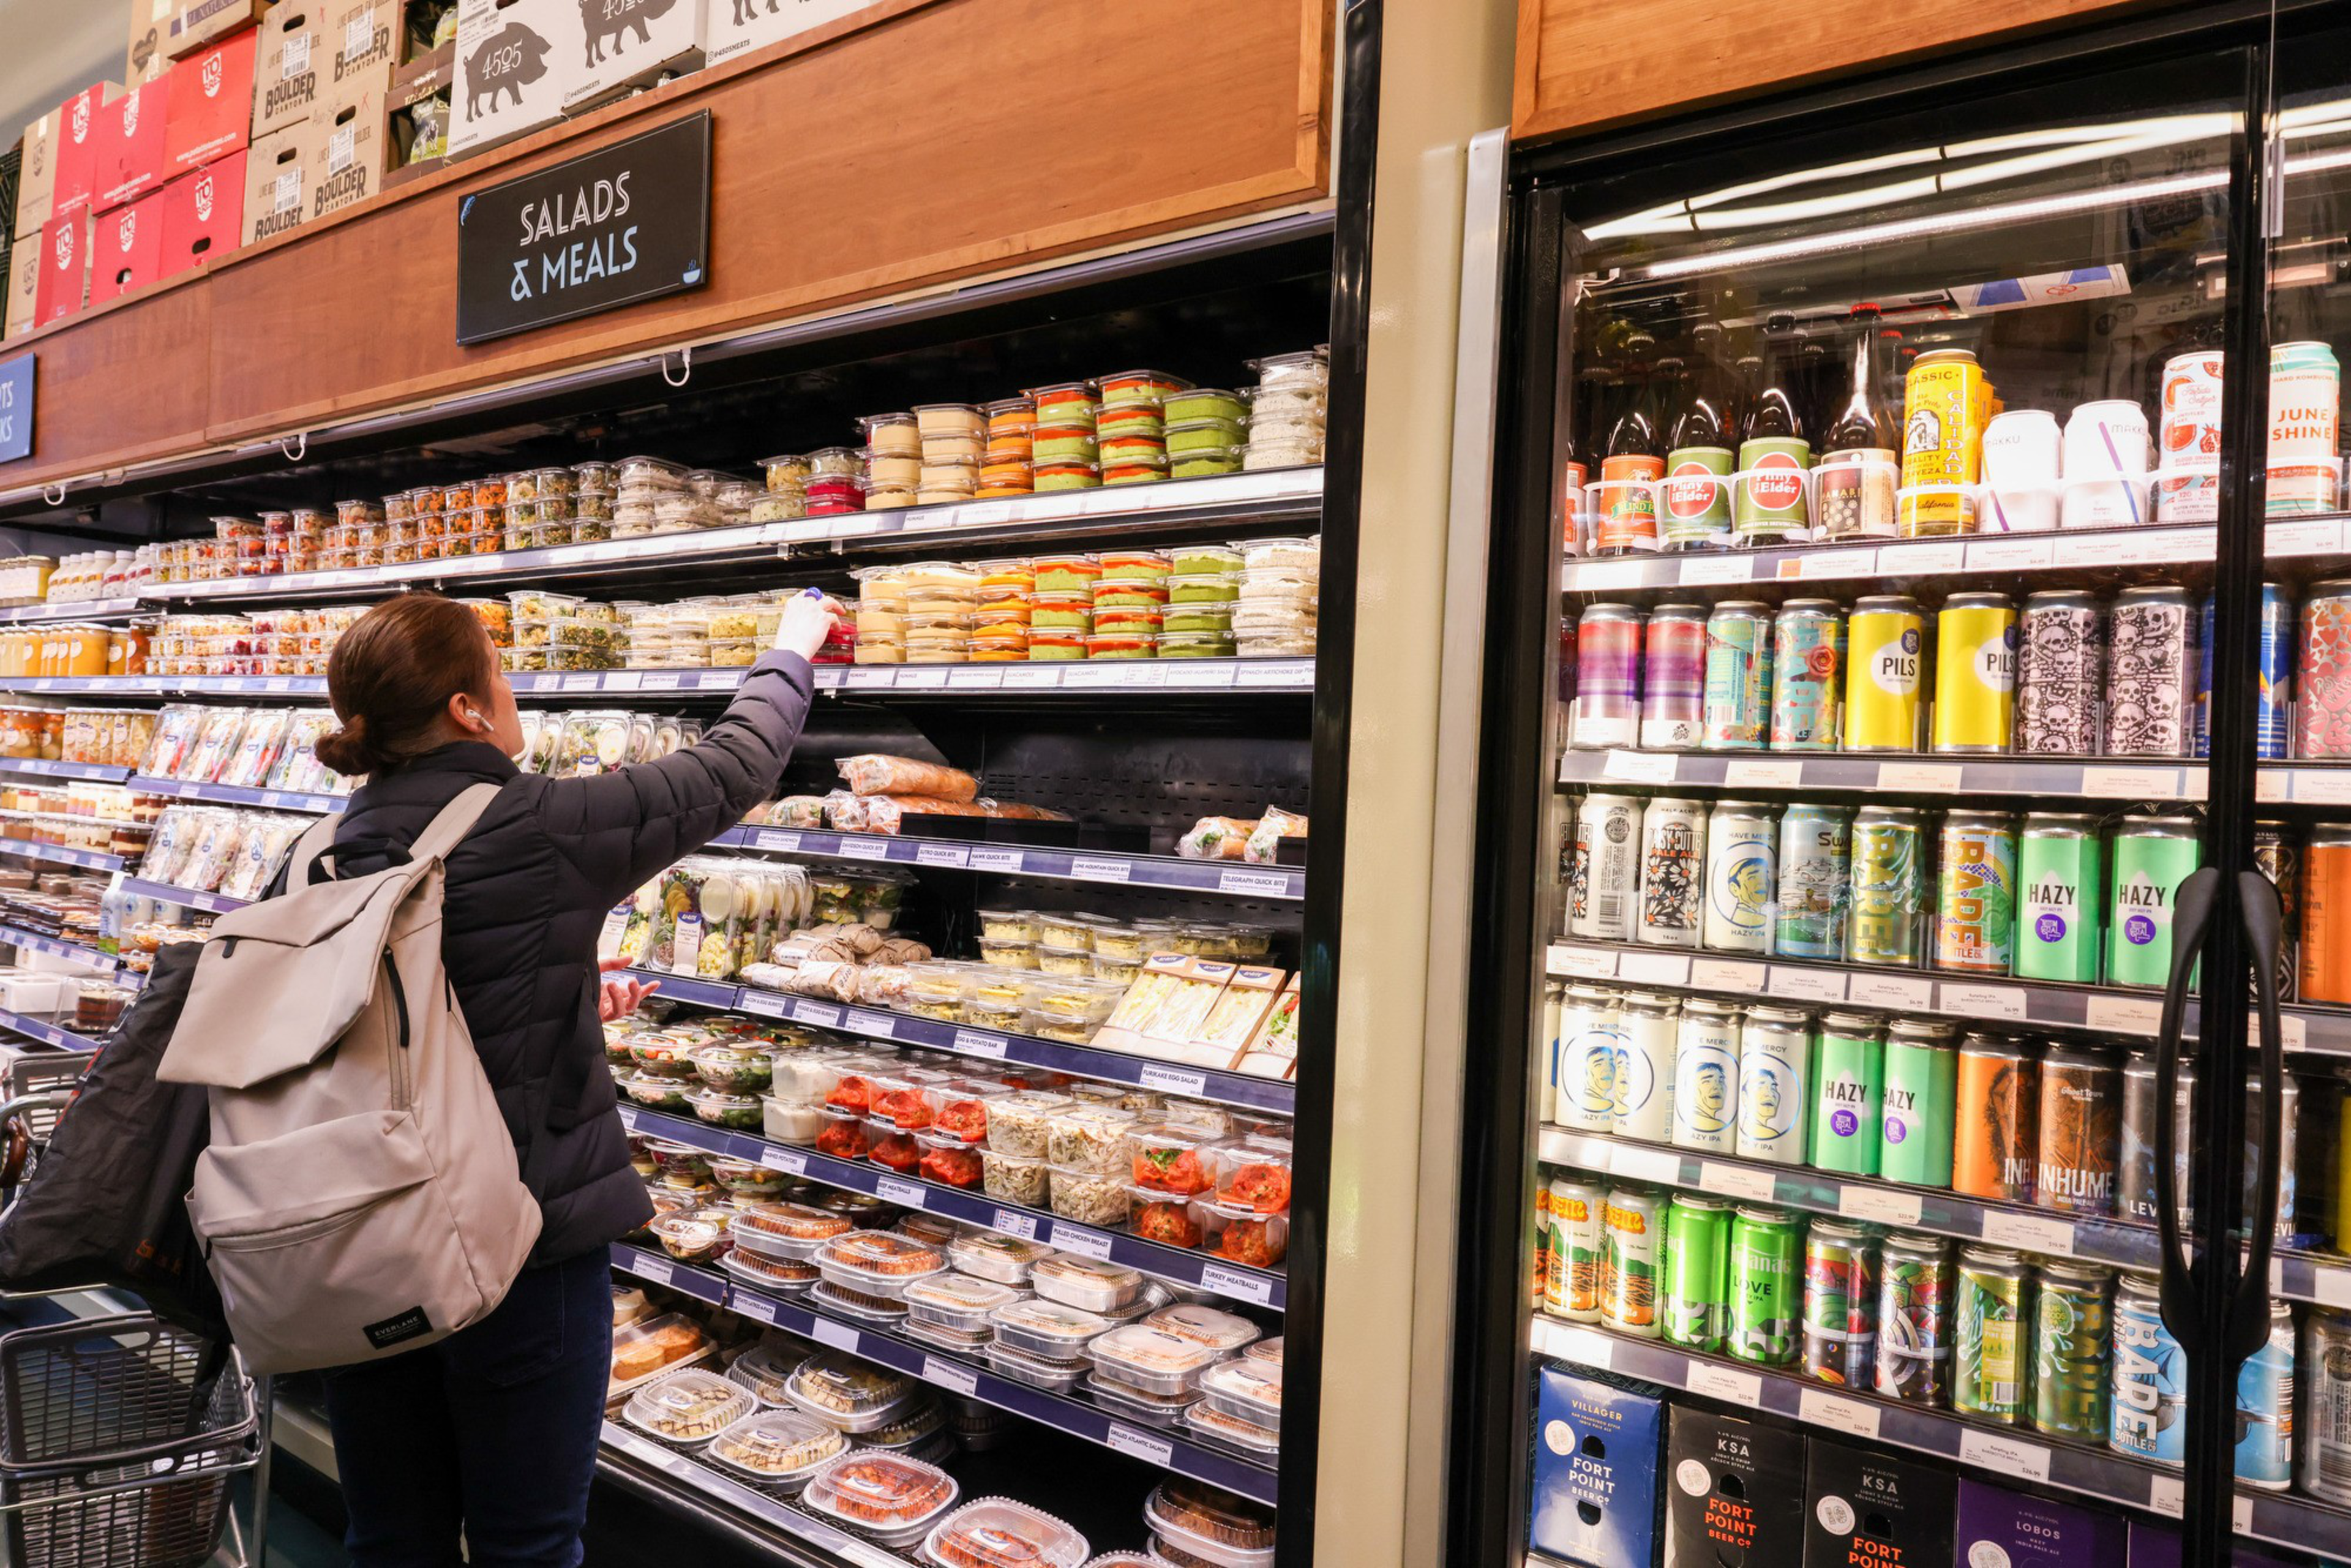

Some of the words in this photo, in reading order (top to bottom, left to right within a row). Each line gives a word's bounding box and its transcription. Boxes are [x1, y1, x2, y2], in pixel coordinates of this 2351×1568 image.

[482, 41, 522, 81] 4505
[264, 71, 315, 120] BOULDER
[276, 99, 302, 115] CANYON
[314, 165, 366, 218] BOULDER
[325, 195, 353, 212] CANYON
[519, 171, 631, 247] SALADS
[511, 259, 532, 302] &
[542, 225, 638, 295] MEALS
[2278, 408, 2328, 422] JUNE
[1944, 390, 1965, 474] CALIDAD
[2272, 427, 2332, 441] SHINE
[1882, 657, 1916, 677] PILS
[1986, 653, 2014, 672] PILS
[1652, 849, 1676, 858] PALE
[1679, 849, 1700, 858] ALE
[1223, 875, 1253, 883] TELEGRAPH
[1254, 877, 1272, 886] QUICK
[2028, 883, 2075, 906] HAZY
[2118, 884, 2167, 907] HAZY
[822, 1010, 838, 1019] BURRITO
[972, 1038, 988, 1047] POTATO
[1142, 1069, 1167, 1079] FURIKAKE
[1168, 1072, 1180, 1082] EGG
[1181, 1075, 1198, 1085] SALAD
[1825, 1079, 1867, 1103] HAZY
[2061, 1087, 2083, 1097] Ghost
[763, 1151, 778, 1161] MASHED
[879, 1182, 888, 1191] BEEF
[888, 1184, 911, 1195] MEATBALLS
[2038, 1162, 2113, 1199] INHUME
[1053, 1227, 1071, 1239] PULLED
[1071, 1232, 1090, 1244] CHICKEN
[1090, 1236, 1109, 1247] BREAST
[2048, 1240, 2067, 1250] $19.99
[1205, 1270, 1226, 1283] TURKEY
[1226, 1274, 1259, 1291] MEATBALLS
[1733, 1275, 1772, 1296] LOVE
[375, 1316, 419, 1337] EVERLANE
[1572, 1399, 1624, 1422] VILLAGER
[1110, 1429, 1128, 1440] GRILLED
[1128, 1433, 1149, 1447] ATLANTIC
[1149, 1439, 1169, 1452] SALMON
[1717, 1438, 1750, 1458] KSA
[1572, 1457, 1613, 1478] FORT
[1730, 1461, 1745, 1471] STYLE
[2022, 1467, 2041, 1477] $26.99
[1569, 1469, 1615, 1494] POINT
[1862, 1474, 1898, 1495] KSA
[1571, 1485, 1594, 1502] BEER
[1709, 1497, 1753, 1521] FORT
[1704, 1511, 1757, 1537] POINT
[2015, 1521, 2061, 1541] LOBOS
[1708, 1528, 1734, 1545] BEER
[1853, 1536, 1902, 1561] FORT
